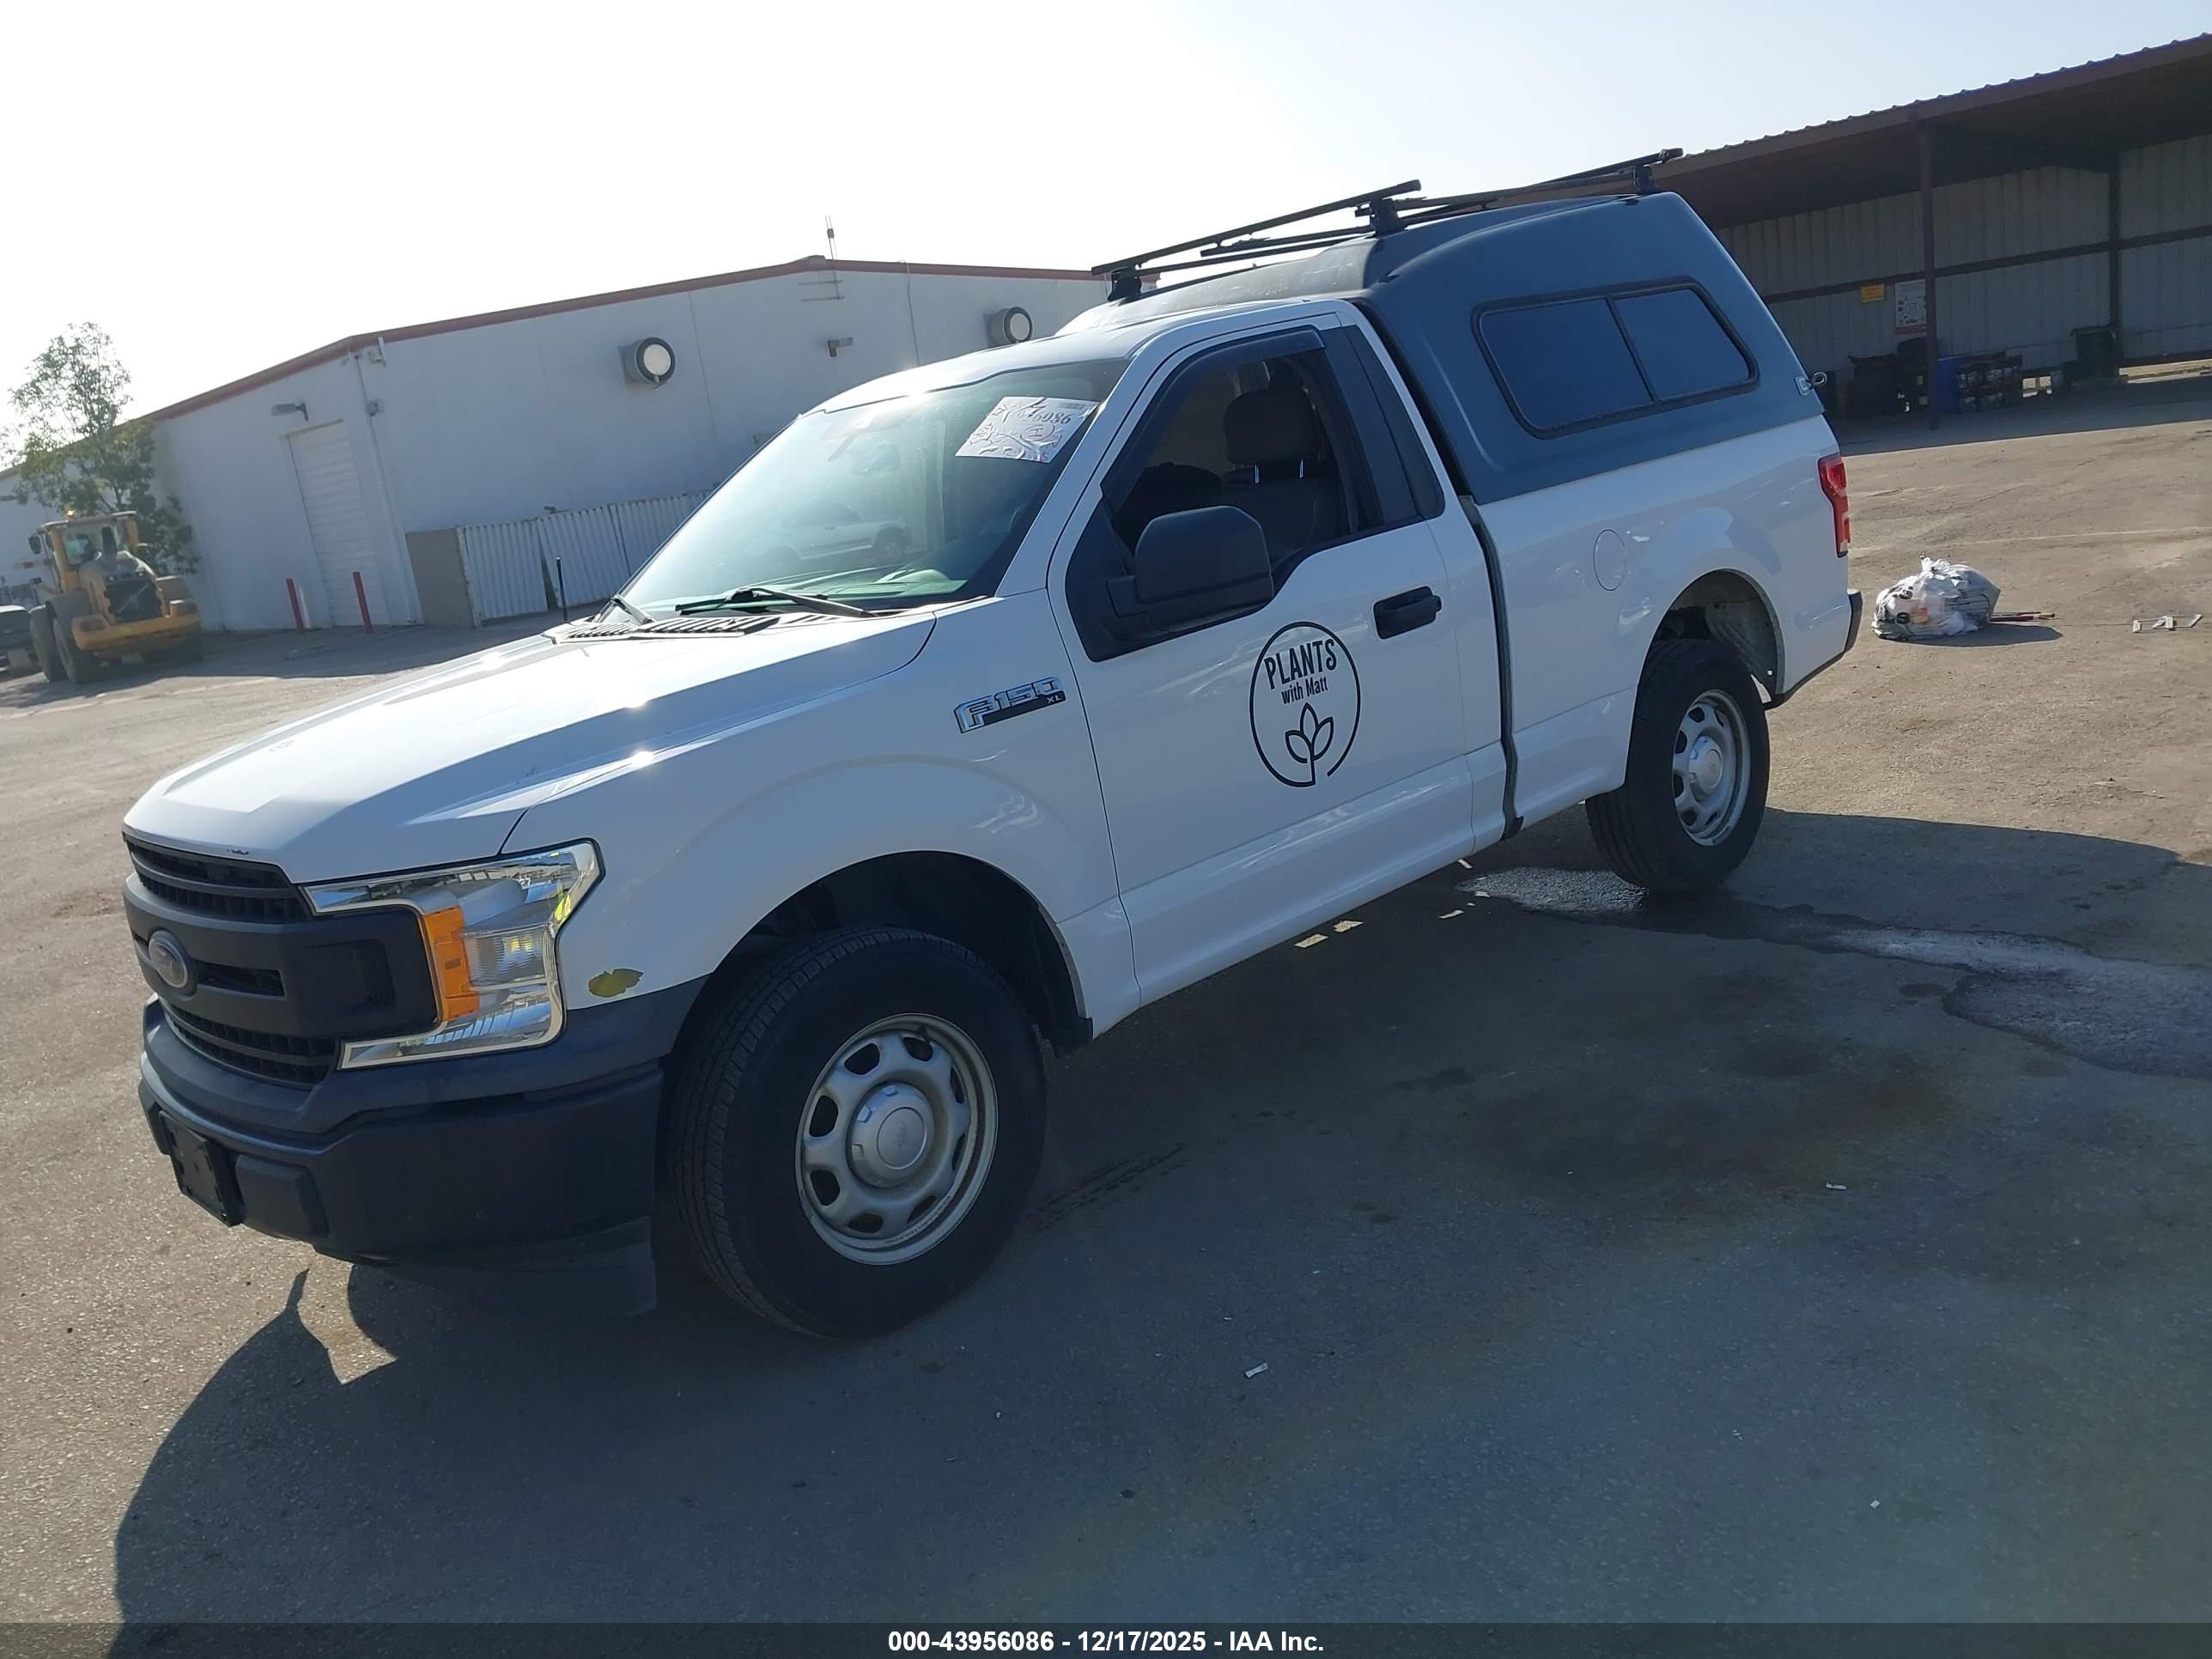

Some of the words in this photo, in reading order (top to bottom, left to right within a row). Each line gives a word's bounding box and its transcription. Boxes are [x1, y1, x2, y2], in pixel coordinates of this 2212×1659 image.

[1263, 638, 1337, 690] PLANTS
[1047, 695, 1063, 704] XL
[1281, 682, 1304, 704] with
[1305, 676, 1328, 697] Matt
